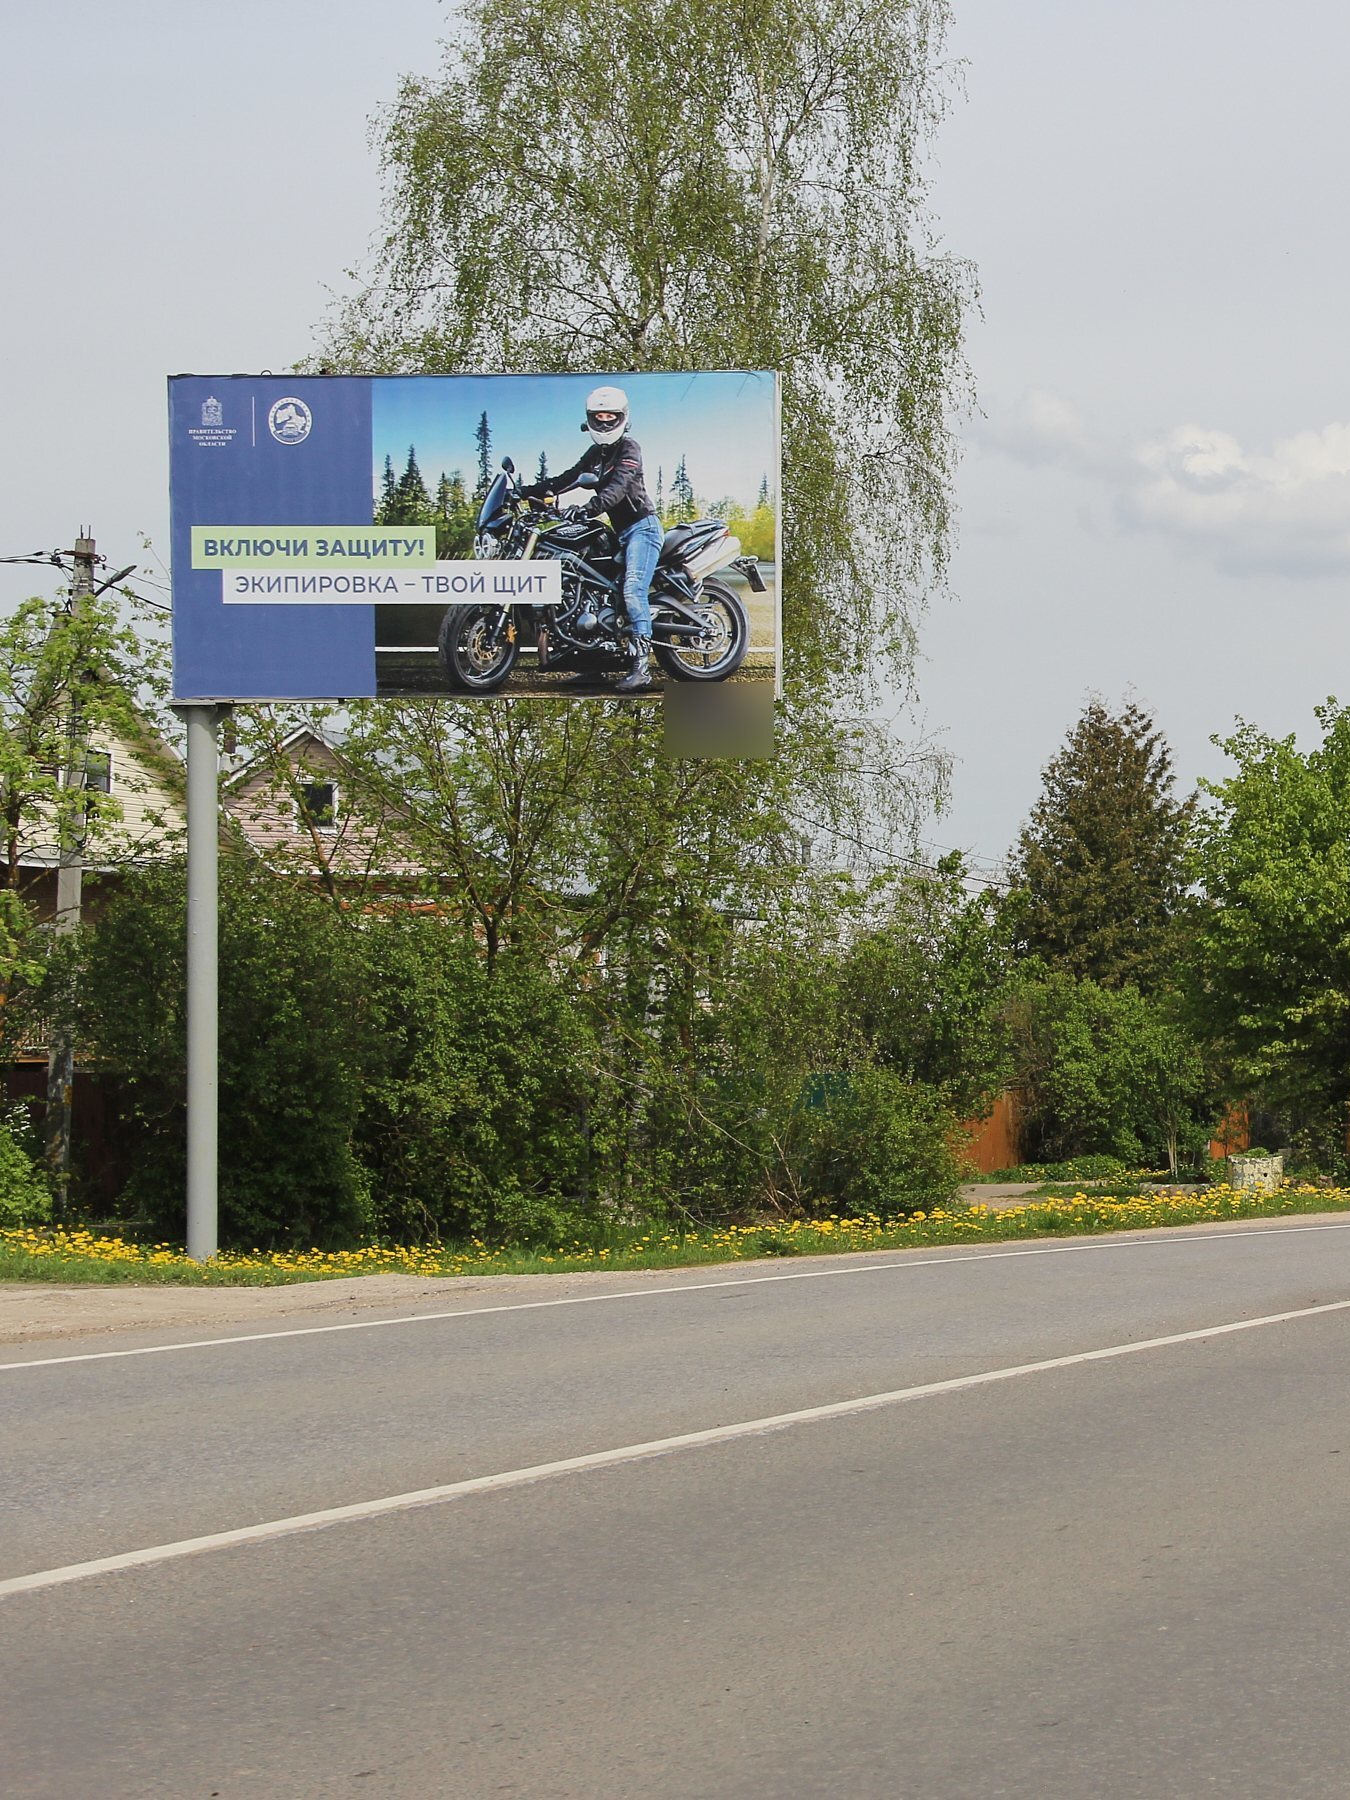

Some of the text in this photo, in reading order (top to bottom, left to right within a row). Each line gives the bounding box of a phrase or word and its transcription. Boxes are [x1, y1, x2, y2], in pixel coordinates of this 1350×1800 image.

[204, 539, 425, 560] ВКЛЮЧИ ЗАЩИТУ!
[235, 576, 399, 593] ЭКИПИРОВКА
[421, 571, 485, 593] ТВОЙ
[493, 576, 547, 597] ЩИТ
